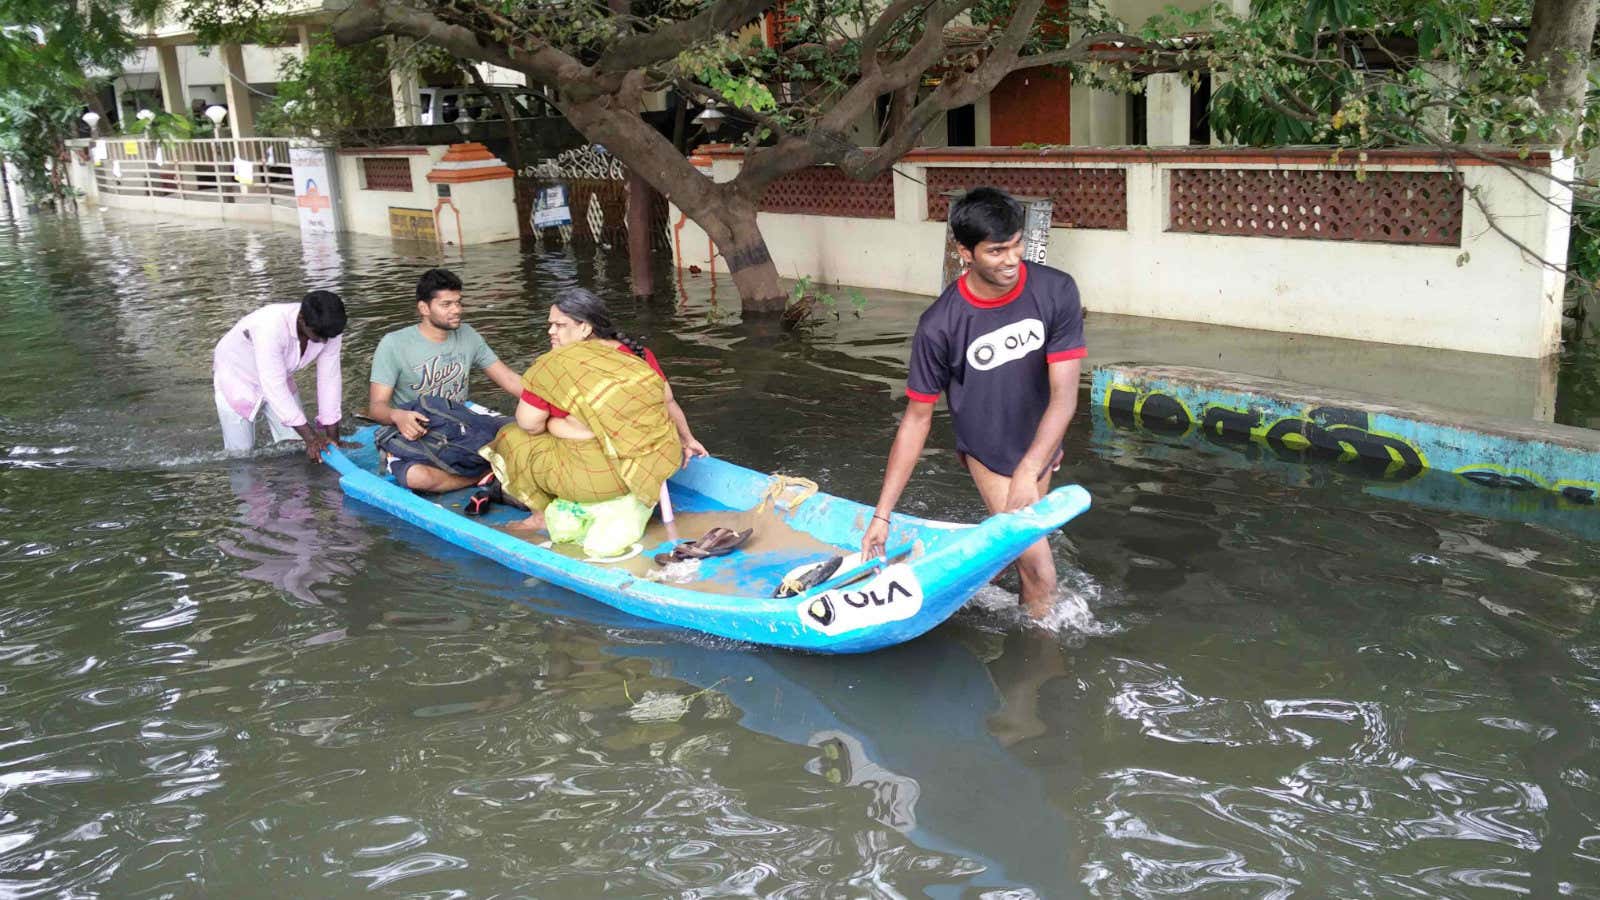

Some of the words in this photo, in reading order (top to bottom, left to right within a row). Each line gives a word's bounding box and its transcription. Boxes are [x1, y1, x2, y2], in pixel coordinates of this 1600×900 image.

[1004, 330, 1041, 350] OLA
[409, 355, 464, 390] New
[843, 580, 913, 609] OLA
